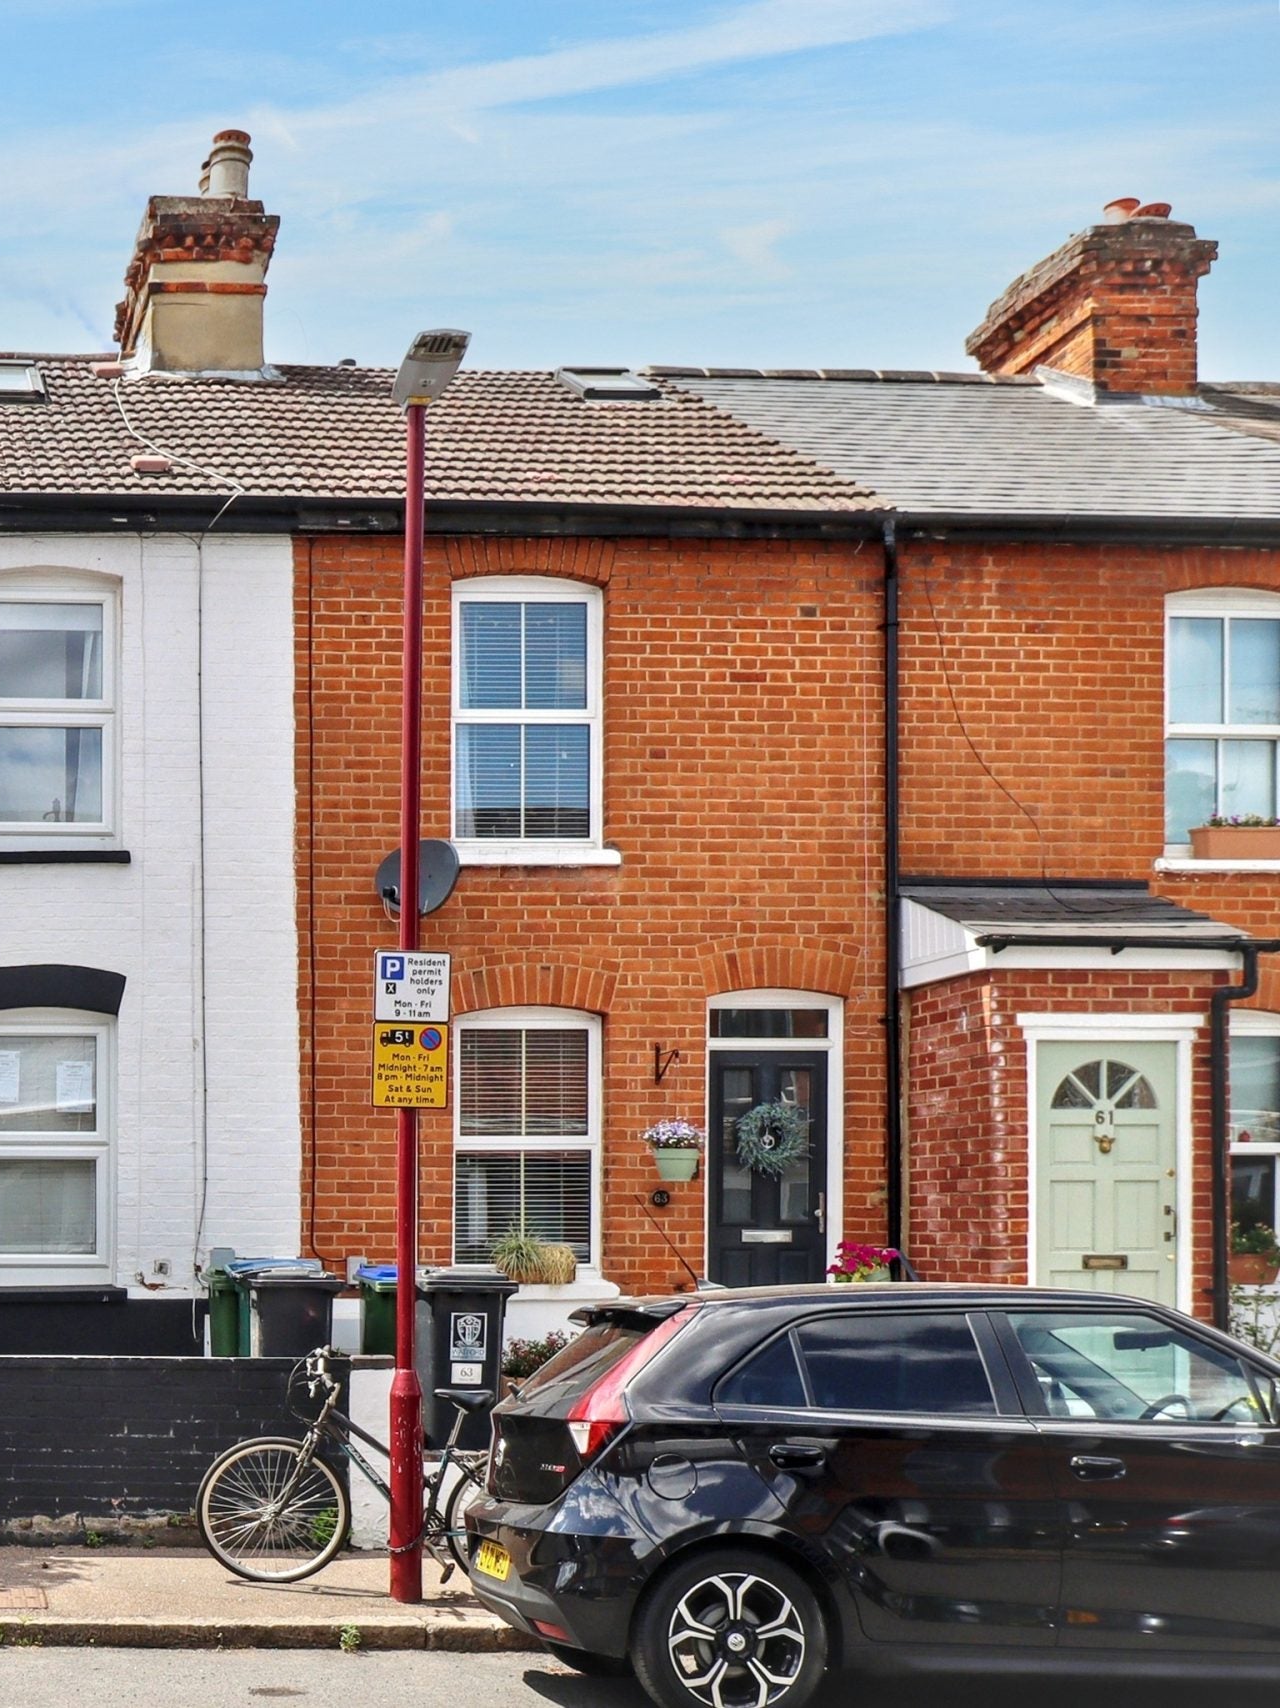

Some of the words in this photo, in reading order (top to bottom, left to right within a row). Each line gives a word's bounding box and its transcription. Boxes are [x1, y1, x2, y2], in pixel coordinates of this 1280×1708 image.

[408, 958, 446, 967] Resident
[412, 968, 441, 976] permit
[410, 977, 443, 986] holders
[387, 983, 395, 993] X
[416, 987, 436, 996] only
[394, 1000, 412, 1008] Mon
[420, 1000, 432, 1008] Fri
[394, 1009, 401, 1017] 9
[392, 1053, 411, 1061] Mon
[417, 1053, 430, 1061] Fri
[378, 1063, 417, 1073] Midnight
[405, 1073, 444, 1083] Midnight
[388, 1084, 403, 1092] Sat
[406, 1085, 412, 1093] &
[415, 1085, 432, 1093] Sun
[384, 1095, 395, 1103] At
[397, 1096, 413, 1104] any
[416, 1096, 435, 1104] time
[1095, 1110, 1113, 1125] 61
[654, 1192, 668, 1203] 63
[460, 1367, 473, 1377] 63
